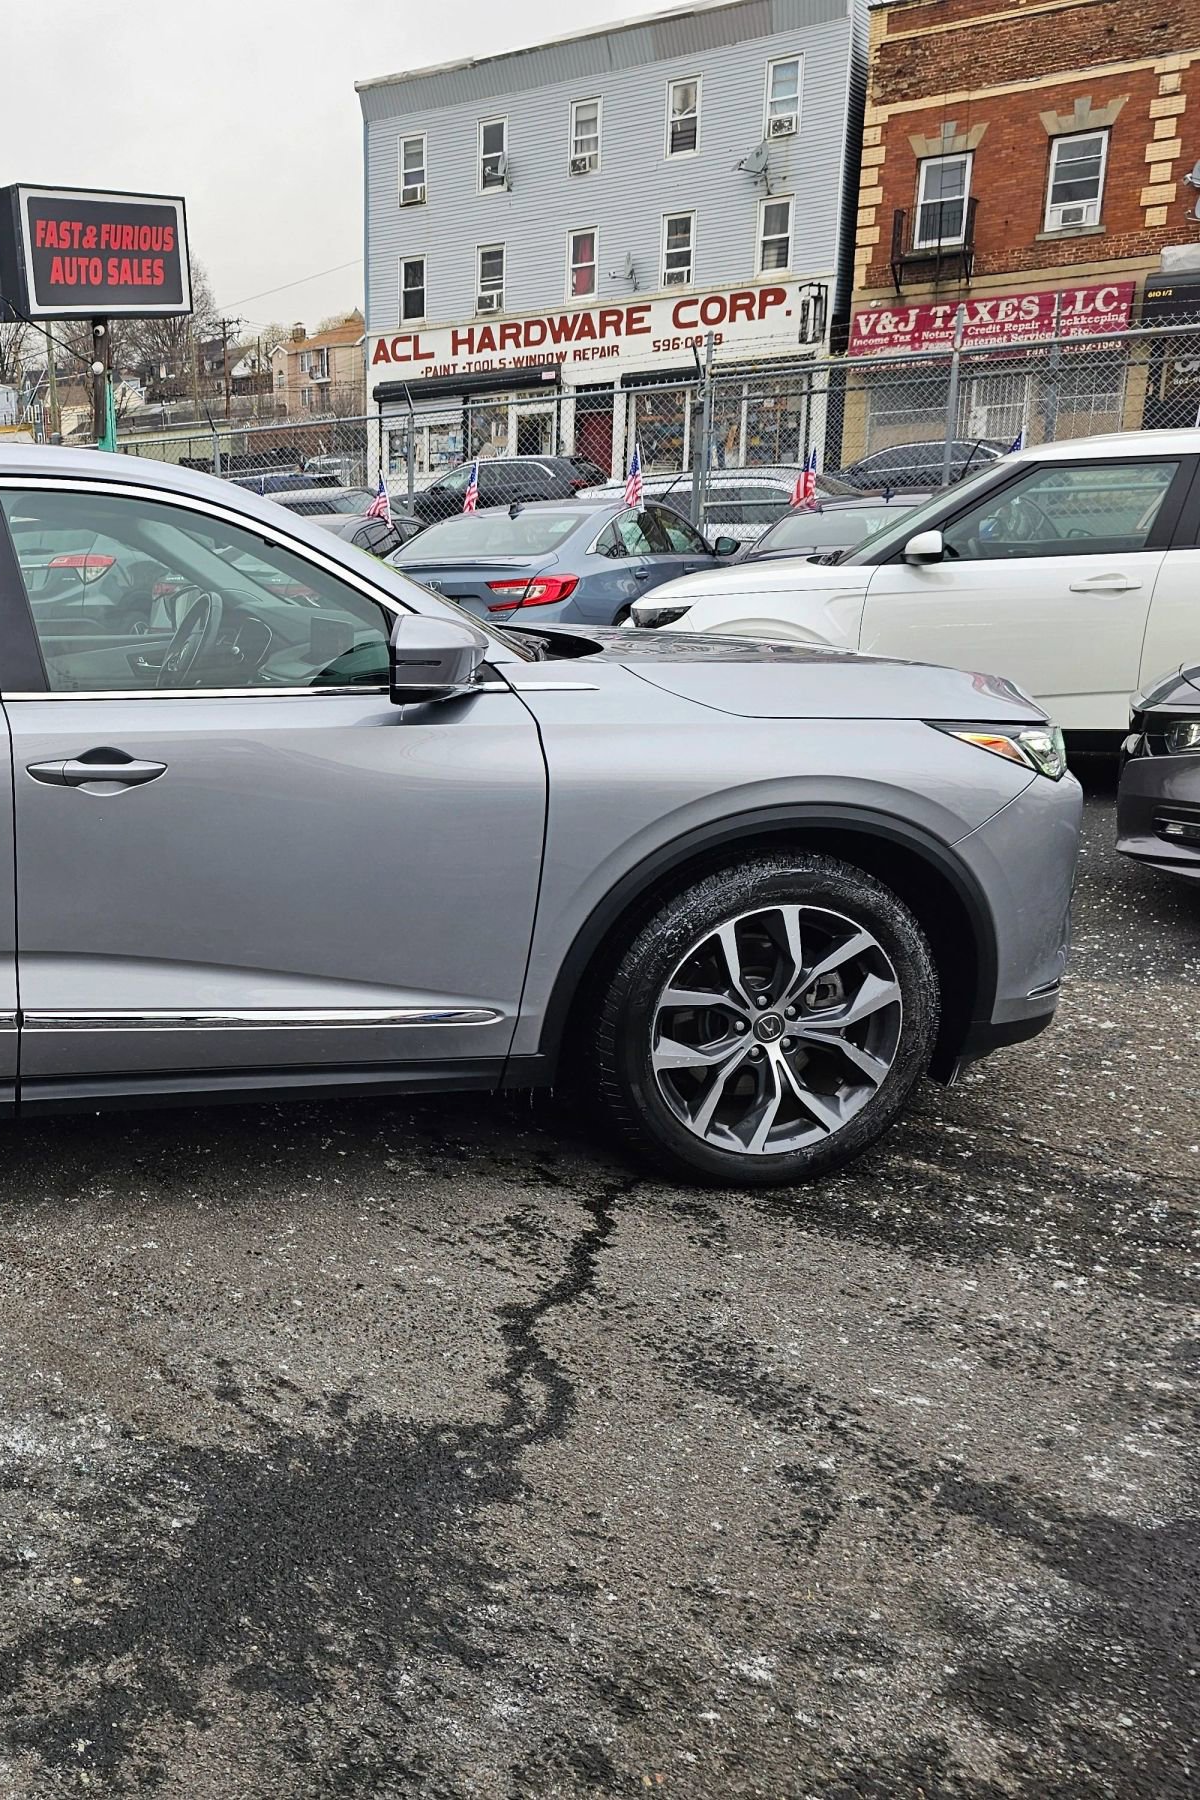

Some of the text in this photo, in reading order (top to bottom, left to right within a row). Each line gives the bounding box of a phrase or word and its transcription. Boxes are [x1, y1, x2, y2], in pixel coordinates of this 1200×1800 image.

[36, 219, 82, 249] FAST
[100, 223, 174, 252] FURIOUS
[50, 256, 165, 285] AUTO SALES
[372, 287, 792, 365] ACL HARDWARE CORP.
[856, 287, 1128, 336] V&J TAXES LLC.
[853, 336, 889, 347] Income
[892, 333, 912, 343] Tax
[967, 323, 1001, 336] Credit
[1003, 320, 1041, 332] Repair
[963, 334, 1008, 347] Internet
[425, 345, 620, 378] PAINT TOOLS WINDOW REPAIR
